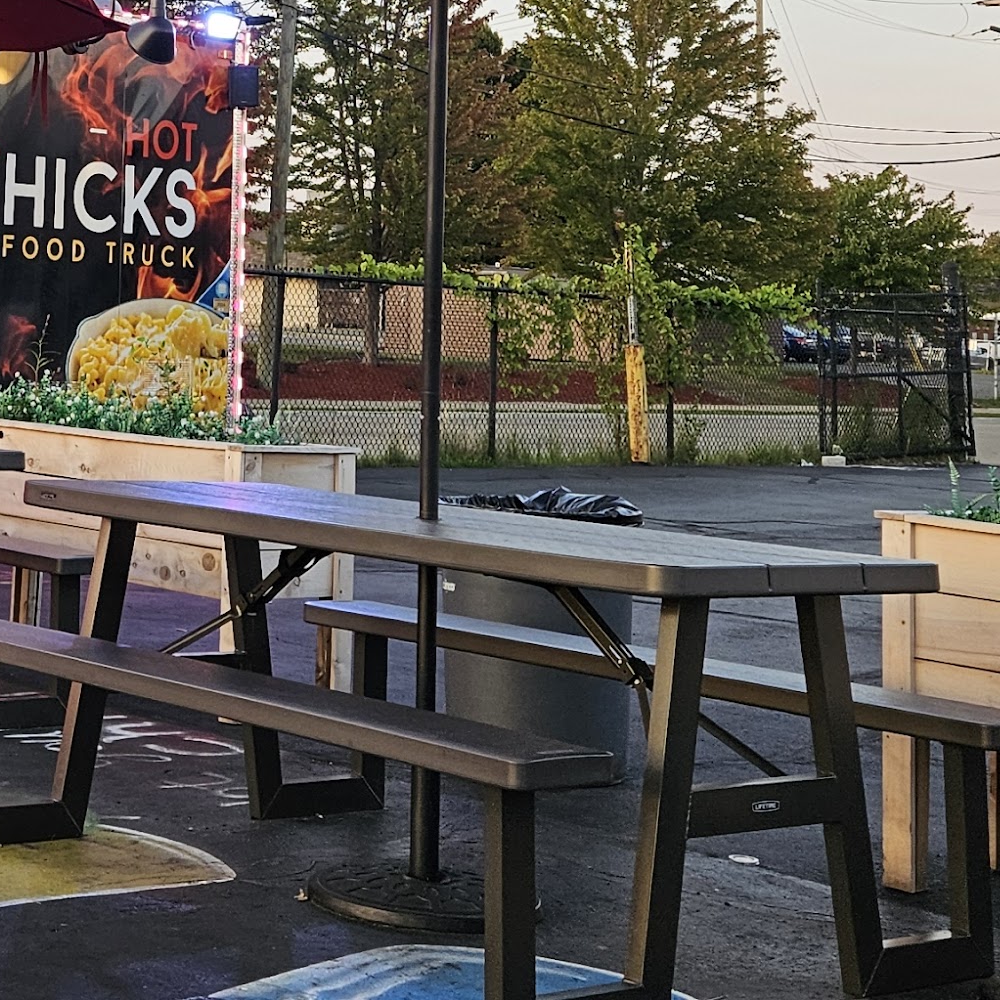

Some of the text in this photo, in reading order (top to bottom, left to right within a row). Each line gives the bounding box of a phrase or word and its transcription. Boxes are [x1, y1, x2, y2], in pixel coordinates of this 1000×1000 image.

[126, 117, 198, 162] HOT
[2, 234, 196, 269] FOOD TRUCK
